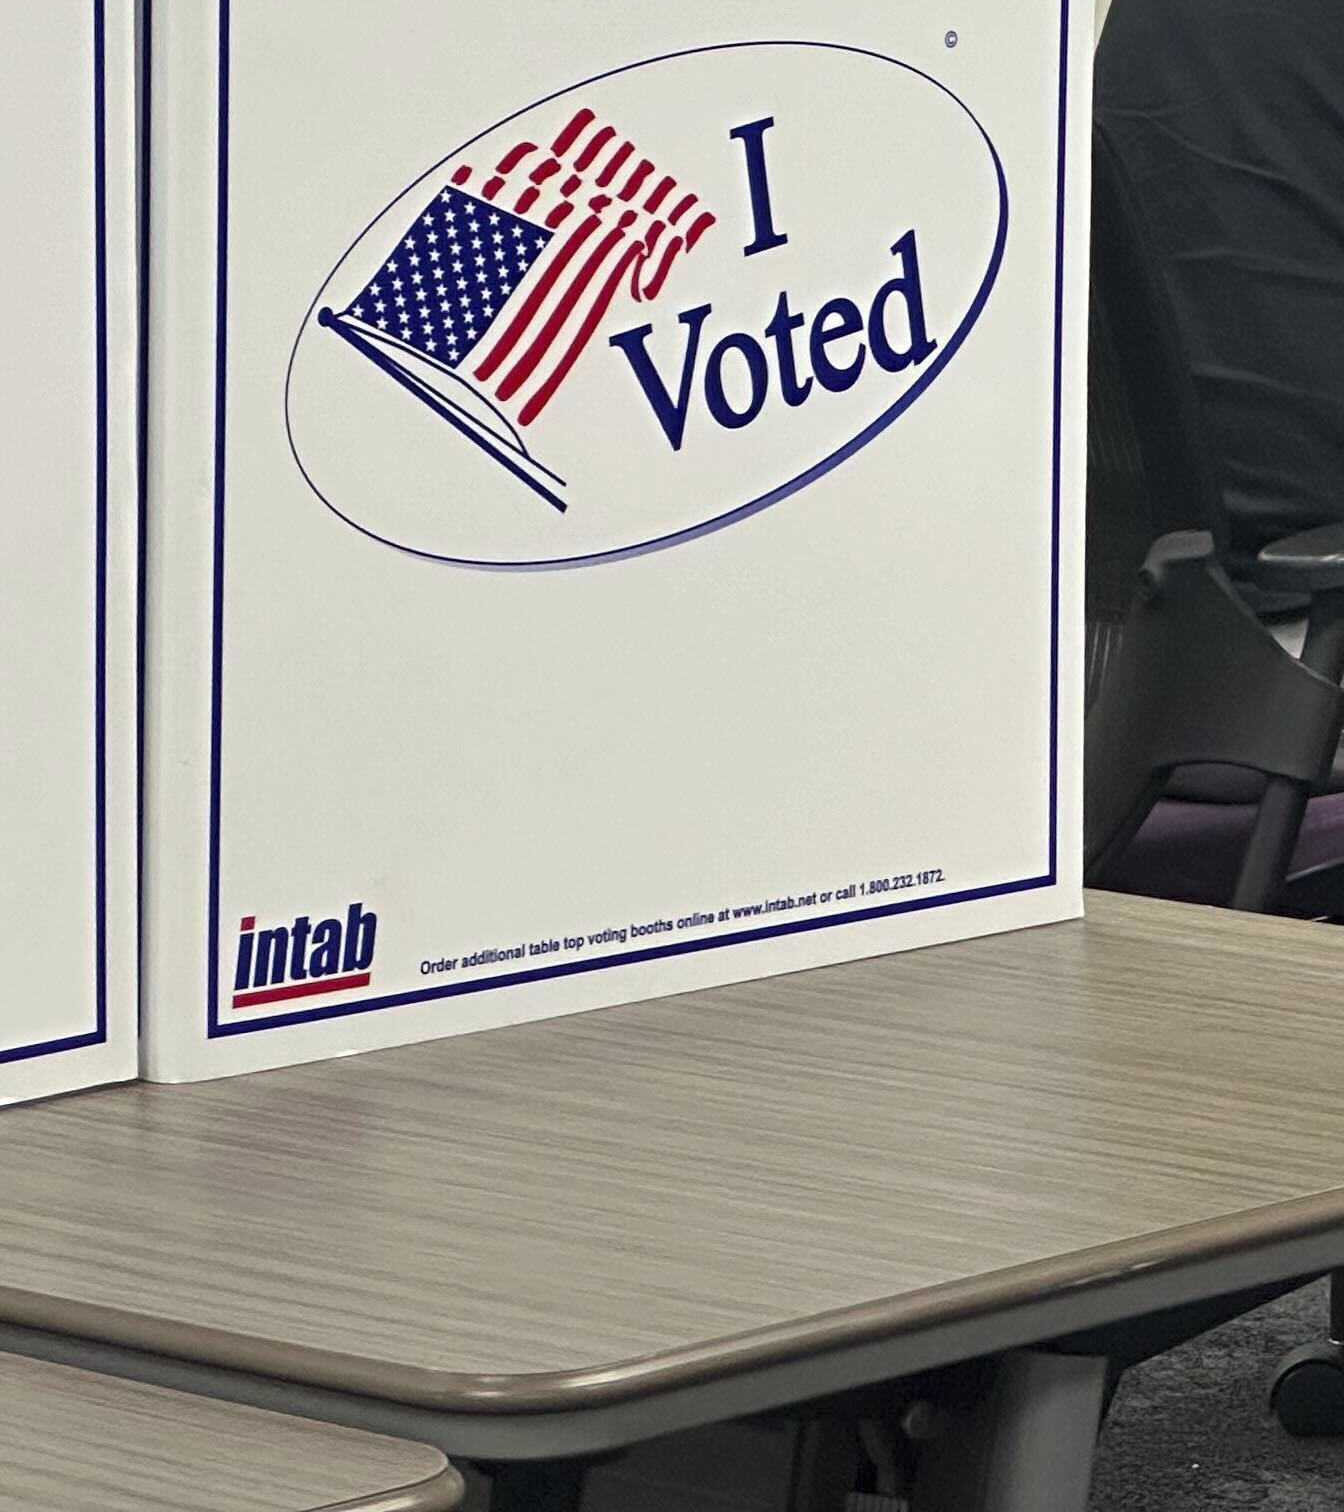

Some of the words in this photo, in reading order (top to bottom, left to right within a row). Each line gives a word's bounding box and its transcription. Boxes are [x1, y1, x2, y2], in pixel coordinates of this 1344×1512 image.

[729, 116, 789, 257] I
[609, 230, 938, 452] Voted
[234, 902, 378, 990] intab
[420, 957, 458, 976] Order
[461, 944, 526, 969] additional
[529, 937, 560, 957] table
[563, 936, 585, 952] top
[588, 926, 628, 946] voting
[630, 919, 673, 938] booths
[677, 912, 714, 929] online
[718, 909, 730, 922] at
[733, 893, 817, 919] www.intab.net
[820, 893, 832, 903] or
[836, 884, 856, 901] call
